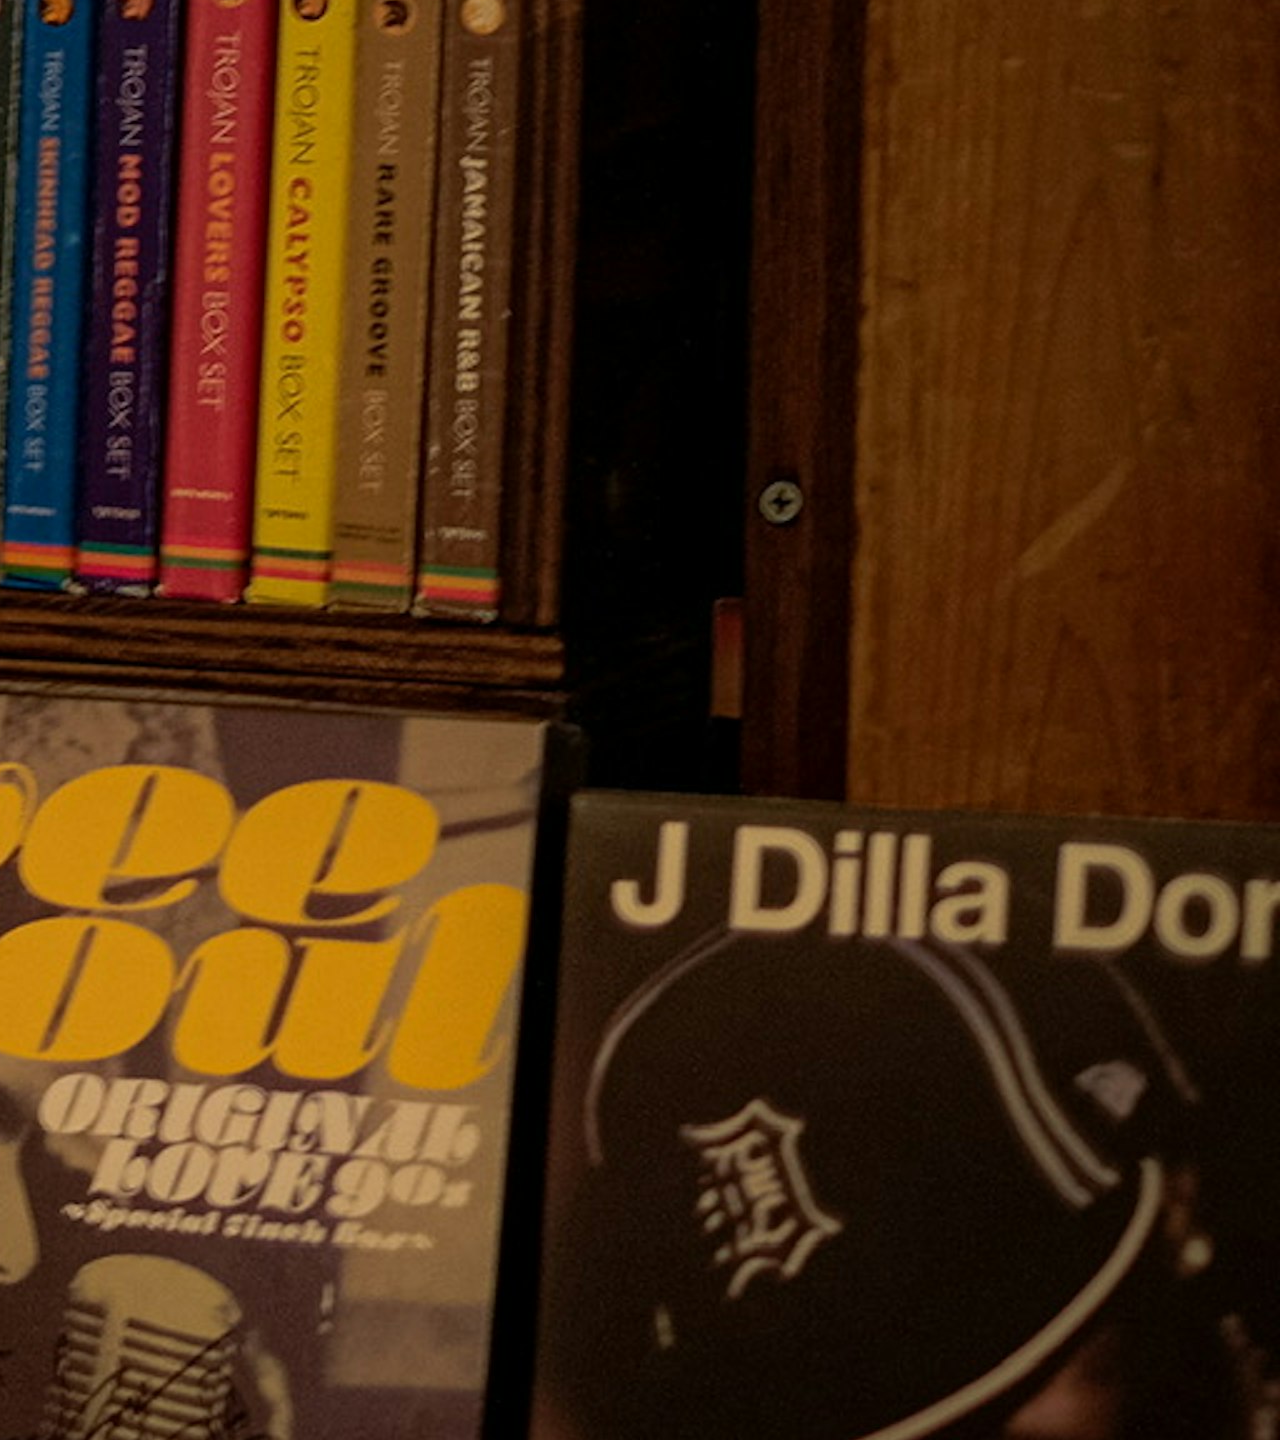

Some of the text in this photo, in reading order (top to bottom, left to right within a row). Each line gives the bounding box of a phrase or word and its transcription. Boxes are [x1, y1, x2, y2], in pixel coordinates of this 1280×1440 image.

[22, 47, 66, 476] TROJAN SKINHEAD REGGAE BOX SET
[104, 43, 151, 482] TROJAN MOD REGGAE BOX SET
[196, 31, 242, 414] TROJAN LOVERS BOX SET
[273, 44, 323, 480] TROJAN CALYPSO BOX SET
[357, 58, 407, 493] TROJAN RARE GROOVE BOX SET
[451, 55, 493, 502] TROJAN JAMAICAN R&B BOX SET
[609, 819, 692, 930] J
[727, 825, 1011, 950] Dilla
[37, 1072, 481, 1161] ORIGINAL
